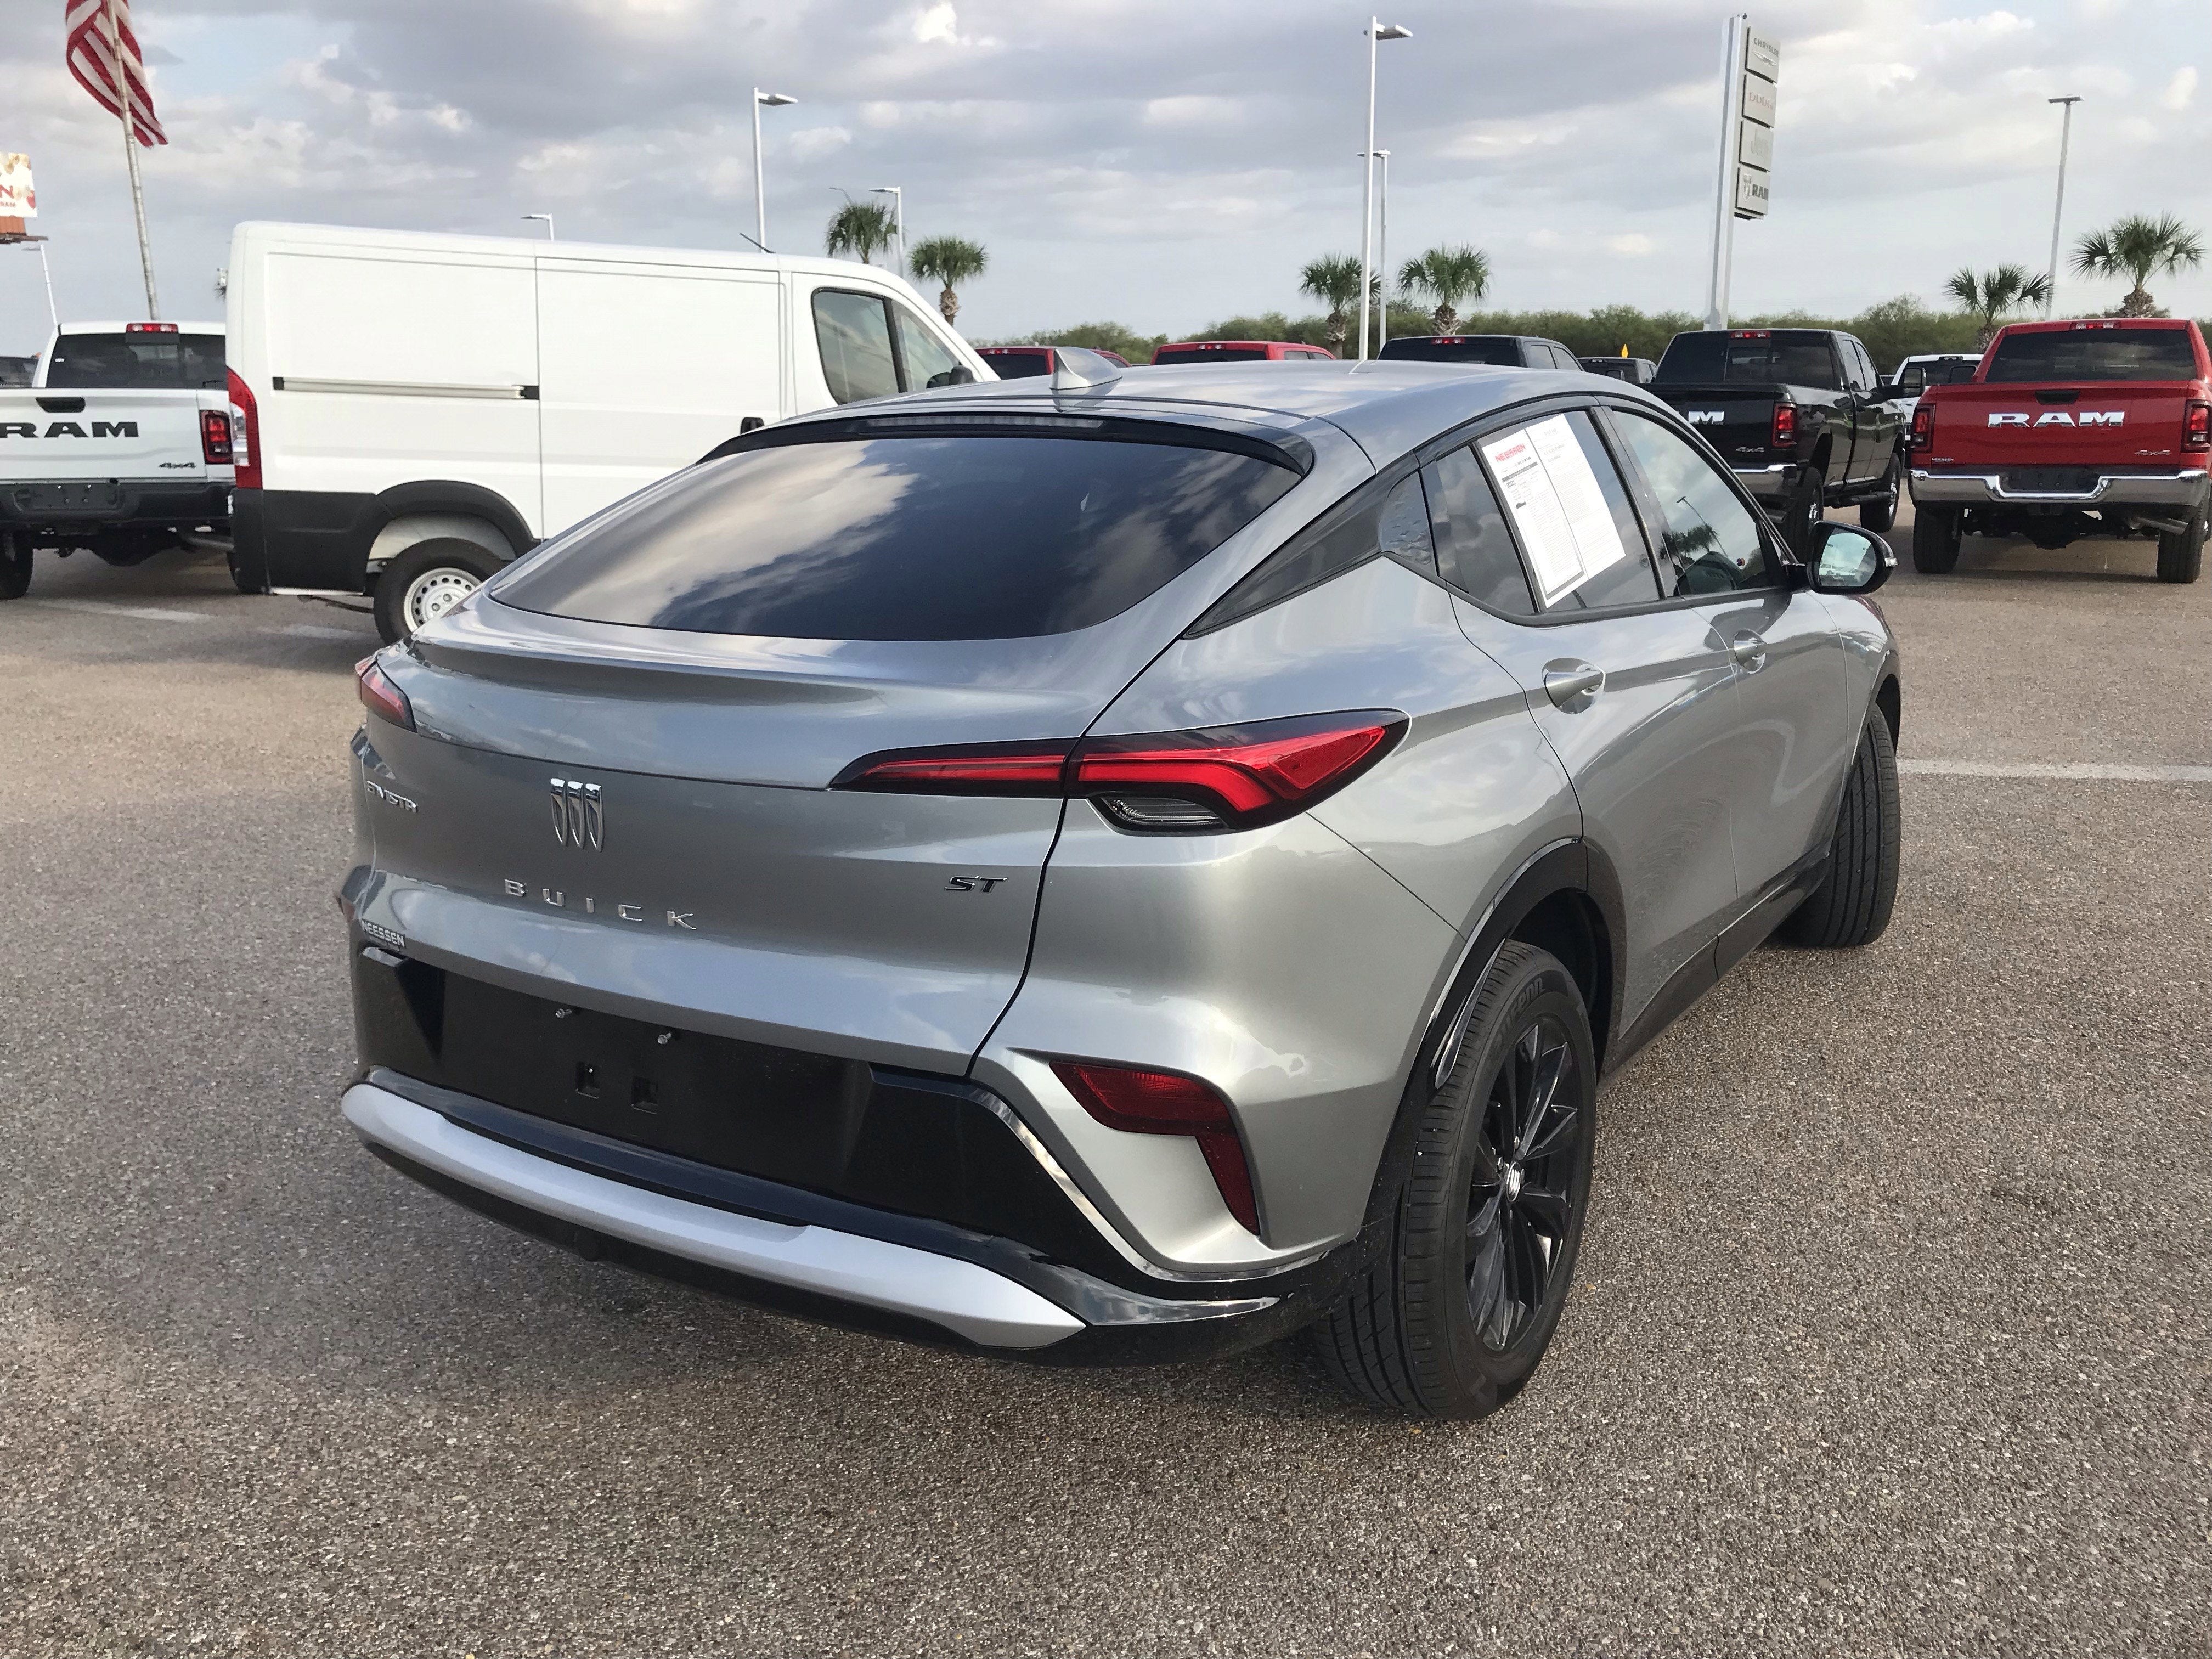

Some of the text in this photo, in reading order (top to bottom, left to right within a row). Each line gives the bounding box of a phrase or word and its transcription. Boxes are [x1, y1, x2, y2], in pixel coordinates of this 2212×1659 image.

[1753, 37, 1779, 57] CHRYSLER
[1752, 184, 1769, 201] RAM
[1988, 411, 2125, 428] RAM
[0, 422, 139, 438] RAM
[1494, 443, 1526, 462] NEESSEN
[945, 876, 1008, 893] ST
[505, 878, 697, 930] BUICK
[359, 918, 405, 947] NEESSEN
